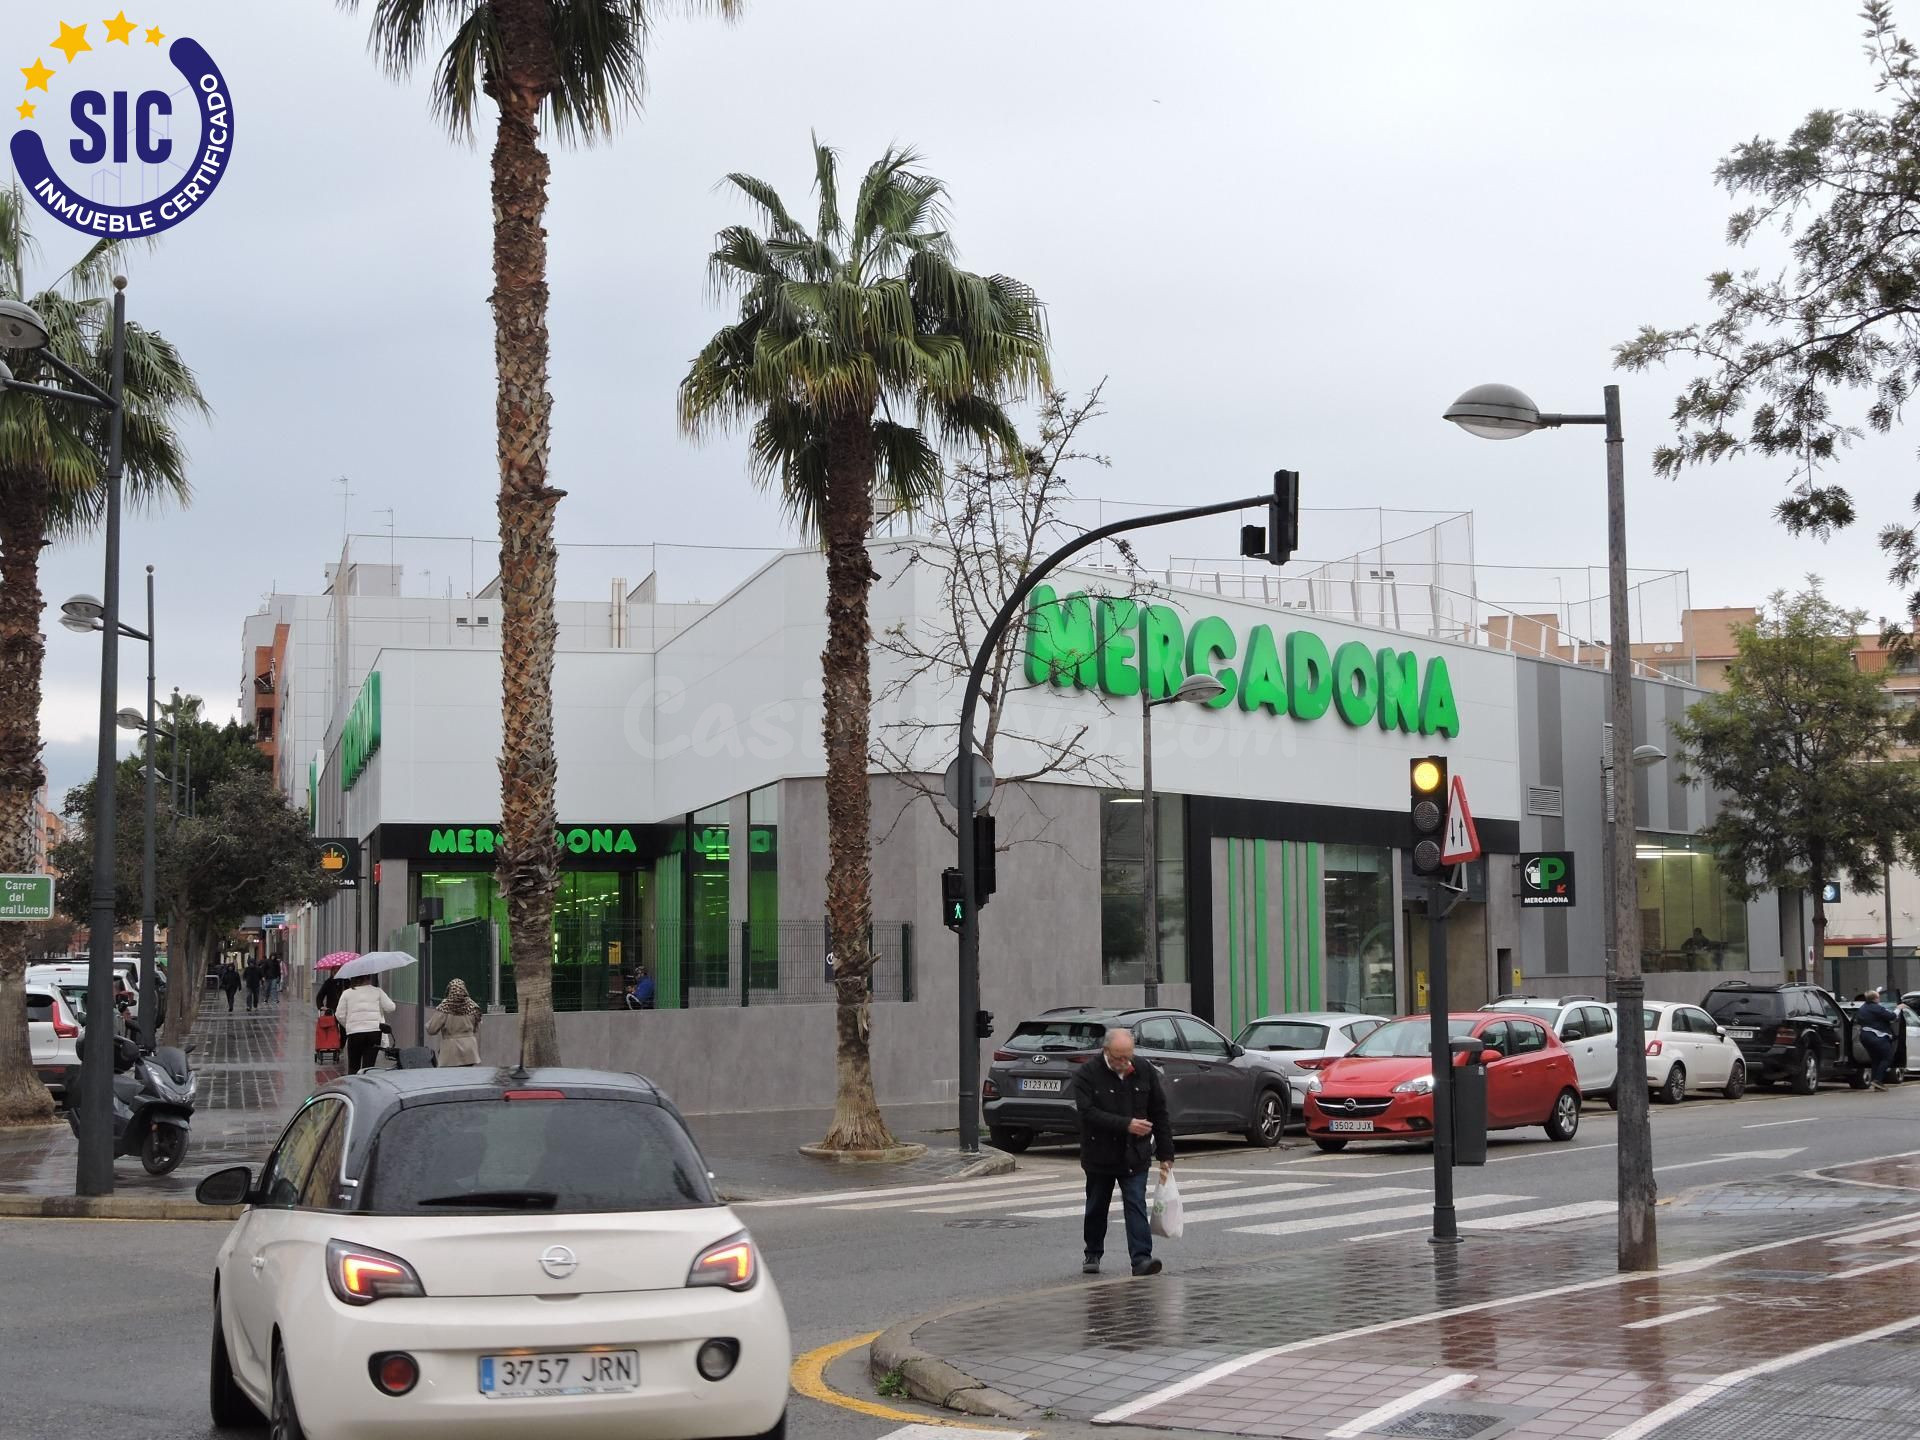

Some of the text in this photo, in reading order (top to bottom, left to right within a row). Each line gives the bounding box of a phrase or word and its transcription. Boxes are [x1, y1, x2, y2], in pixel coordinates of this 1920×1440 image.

[1024, 584, 1459, 739] MERCADONA
[428, 828, 637, 853] MERONA
[5, 880, 37, 890] Carrer
[9, 893, 25, 902] del
[1524, 896, 1569, 904] MERCADONA
[18, 904, 49, 915] Llorens
[1023, 1080, 1059, 1091] 9123 KXX
[1334, 1121, 1354, 1131] 3502
[501, 1356, 632, 1386] 3757 JRN
